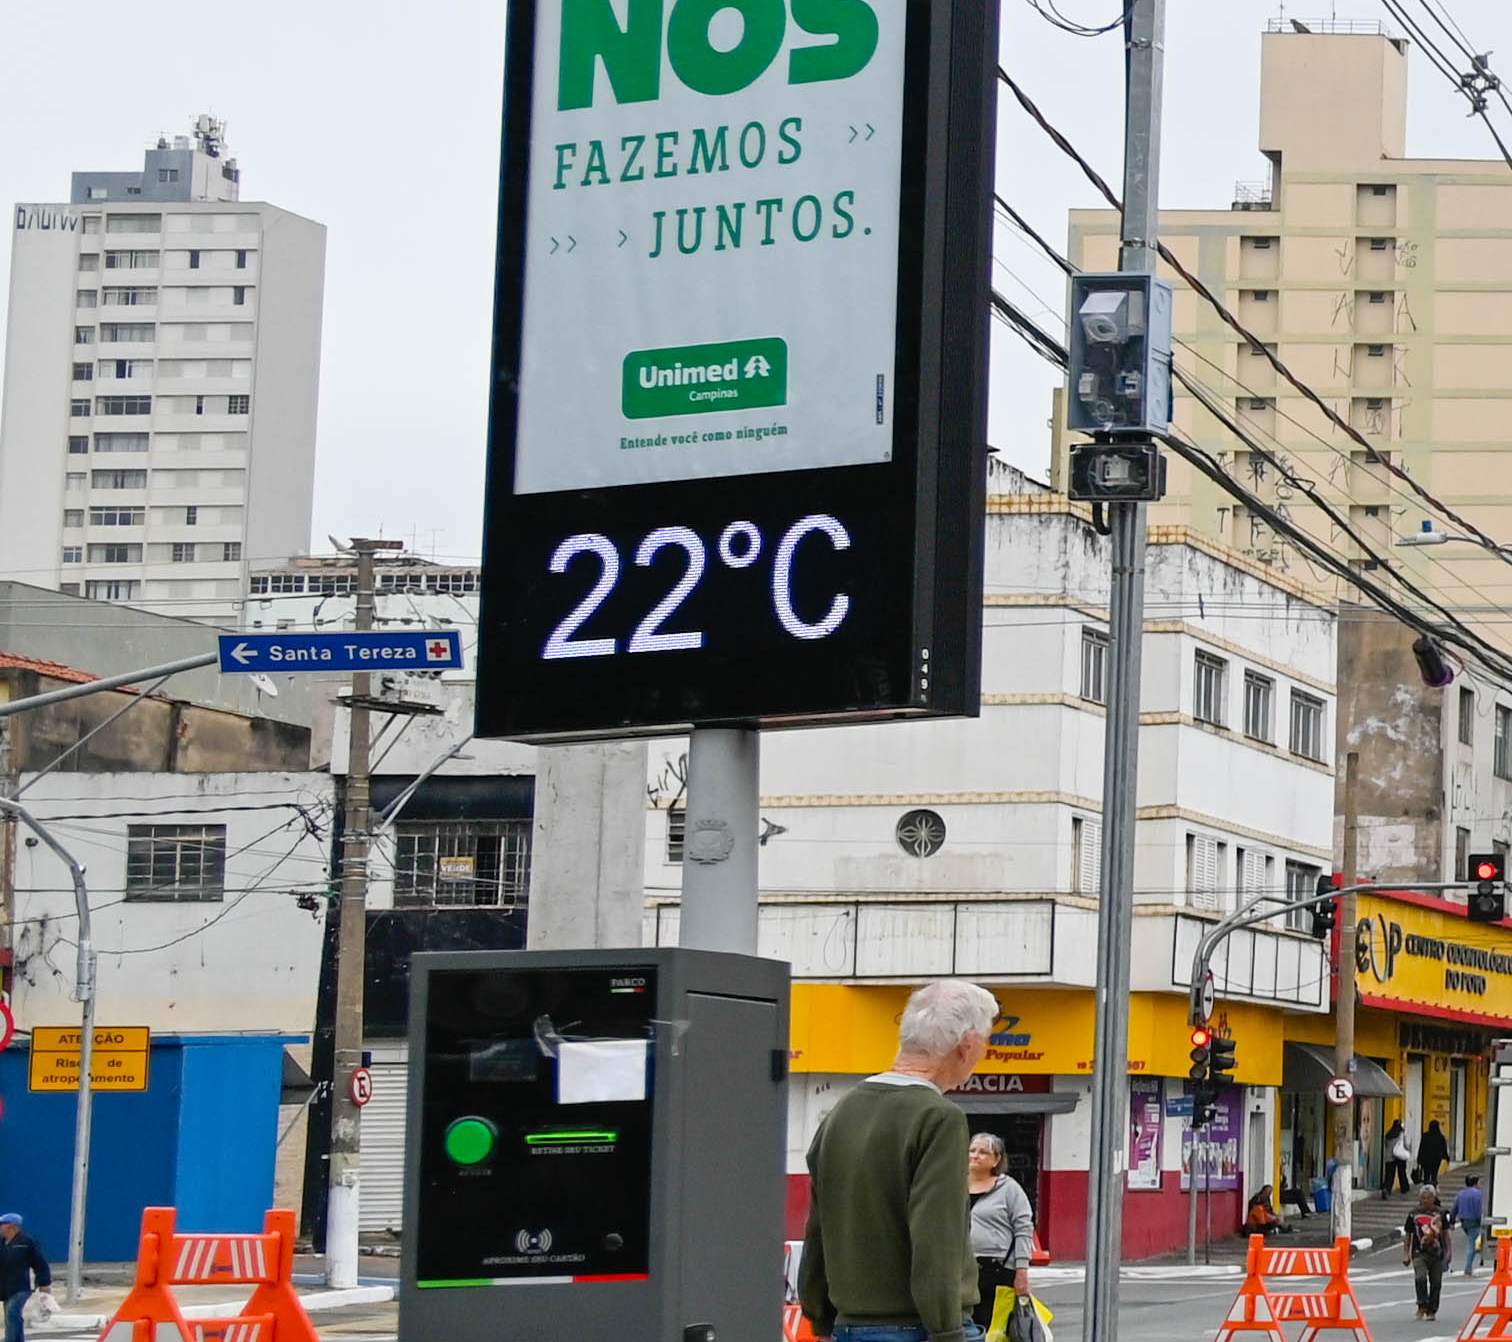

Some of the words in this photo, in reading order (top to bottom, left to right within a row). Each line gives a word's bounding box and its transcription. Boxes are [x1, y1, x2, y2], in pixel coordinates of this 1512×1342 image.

[552, 117, 803, 191] FAZEMOS
[648, 189, 873, 259] JUNTOS.
[639, 358, 739, 389] Unimed
[689, 387, 739, 404] Campinas
[619, 433, 668, 450] Entende
[670, 431, 699, 446] você
[702, 429, 732, 443] como
[736, 422, 788, 441] ninguém
[542, 513, 851, 660] 22°C
[269, 645, 332, 661] Santa
[344, 644, 417, 660] Tereza
[1405, 934, 1445, 961] CENTRO
[610, 978, 646, 988] PARCO
[1445, 968, 1460, 991] DO
[1460, 970, 1487, 996] POVO
[58, 1032, 125, 1045] ATEÇÃO
[107, 1058, 123, 1068] de
[985, 1049, 1045, 1063] Popular
